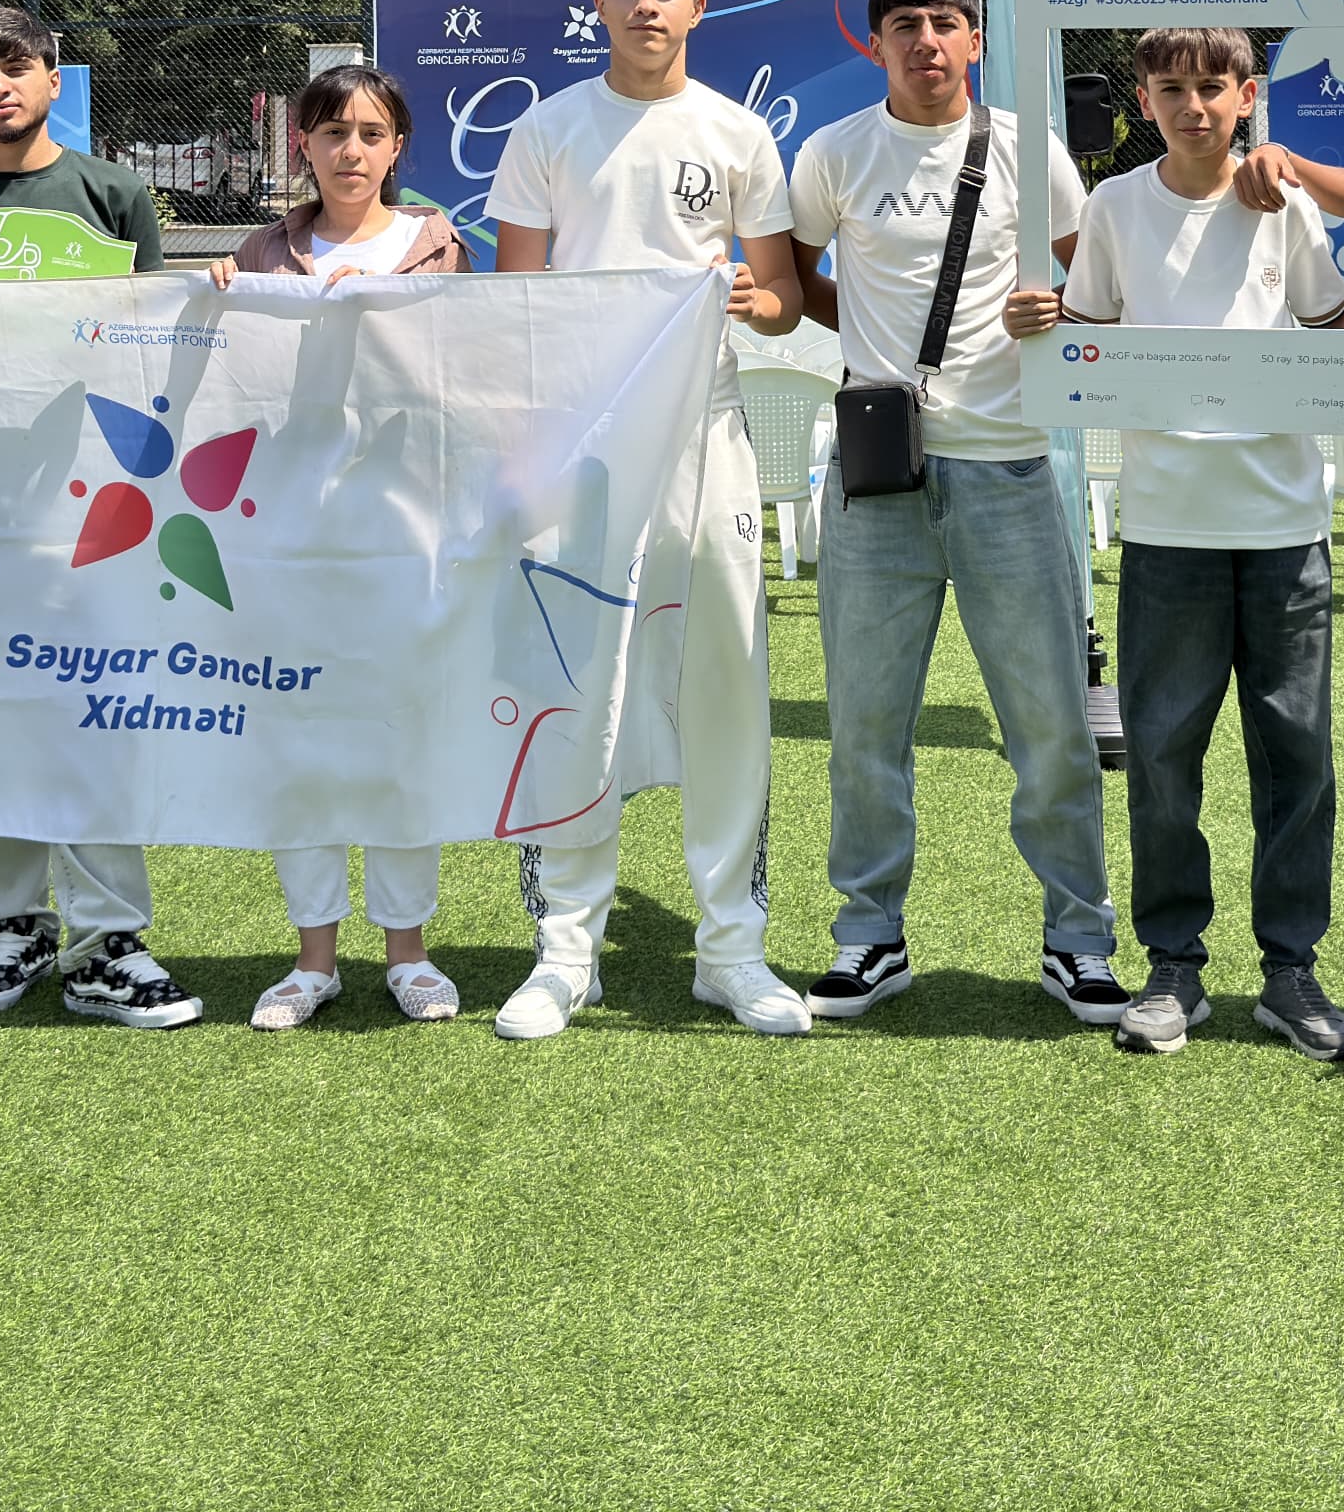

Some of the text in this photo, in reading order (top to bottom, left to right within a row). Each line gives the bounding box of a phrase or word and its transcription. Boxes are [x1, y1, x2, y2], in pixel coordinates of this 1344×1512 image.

[417, 55, 470, 65] GƏNCLƏR
[472, 55, 509, 64] FONDU
[669, 159, 721, 213] Dior
[109, 332, 228, 349] GƏNCLƏR FONDU
[1104, 351, 1130, 361] AzGF
[1261, 354, 1274, 363] 50
[1297, 355, 1310, 364] 30
[1312, 397, 1344, 409] Paylaş
[732, 513, 758, 543] Dior
[5, 633, 323, 692] Səyyar Gənclər
[78, 693, 247, 736] Xidməti
